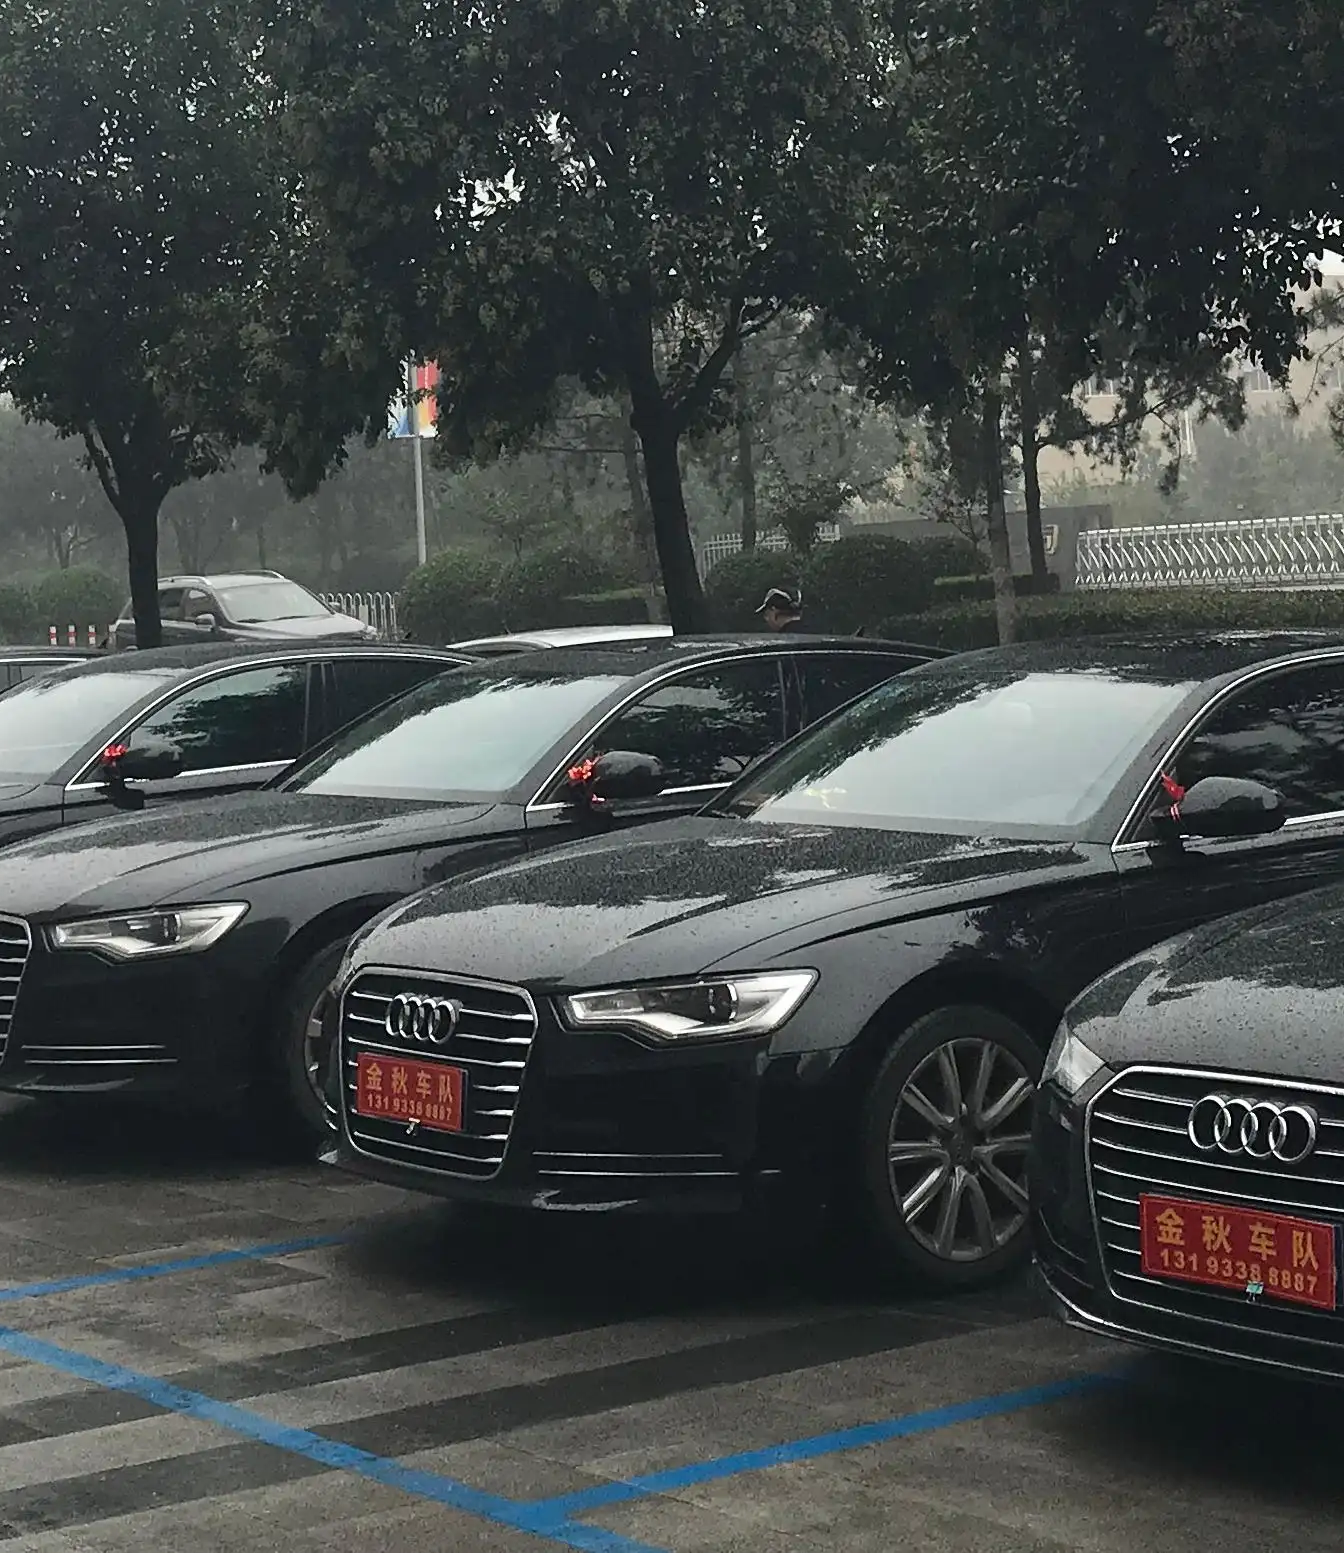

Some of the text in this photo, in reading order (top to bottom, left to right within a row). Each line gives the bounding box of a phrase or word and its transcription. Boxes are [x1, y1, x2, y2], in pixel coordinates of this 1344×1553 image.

[366, 1063, 453, 1103] 金秋车队
[367, 1093, 389, 1110] 131
[1156, 1208, 1319, 1270] 金秋车队
[1160, 1249, 1318, 1295] 131 9338 8887
